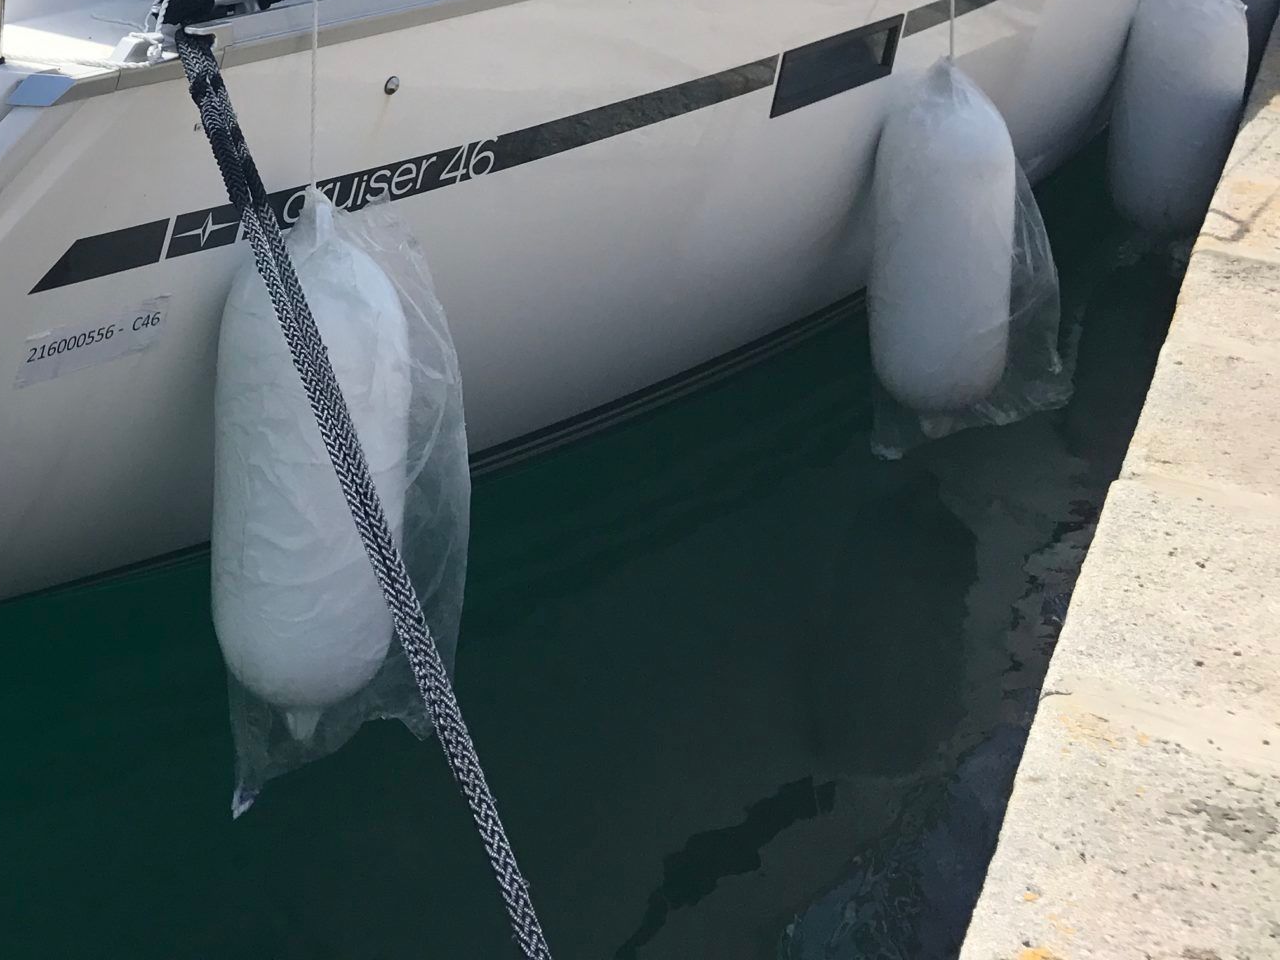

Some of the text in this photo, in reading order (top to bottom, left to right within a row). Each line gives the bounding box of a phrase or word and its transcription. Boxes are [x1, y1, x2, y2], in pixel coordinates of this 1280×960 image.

[439, 136, 499, 185] 46
[26, 324, 116, 364] 216000556
[132, 311, 161, 332] C46
